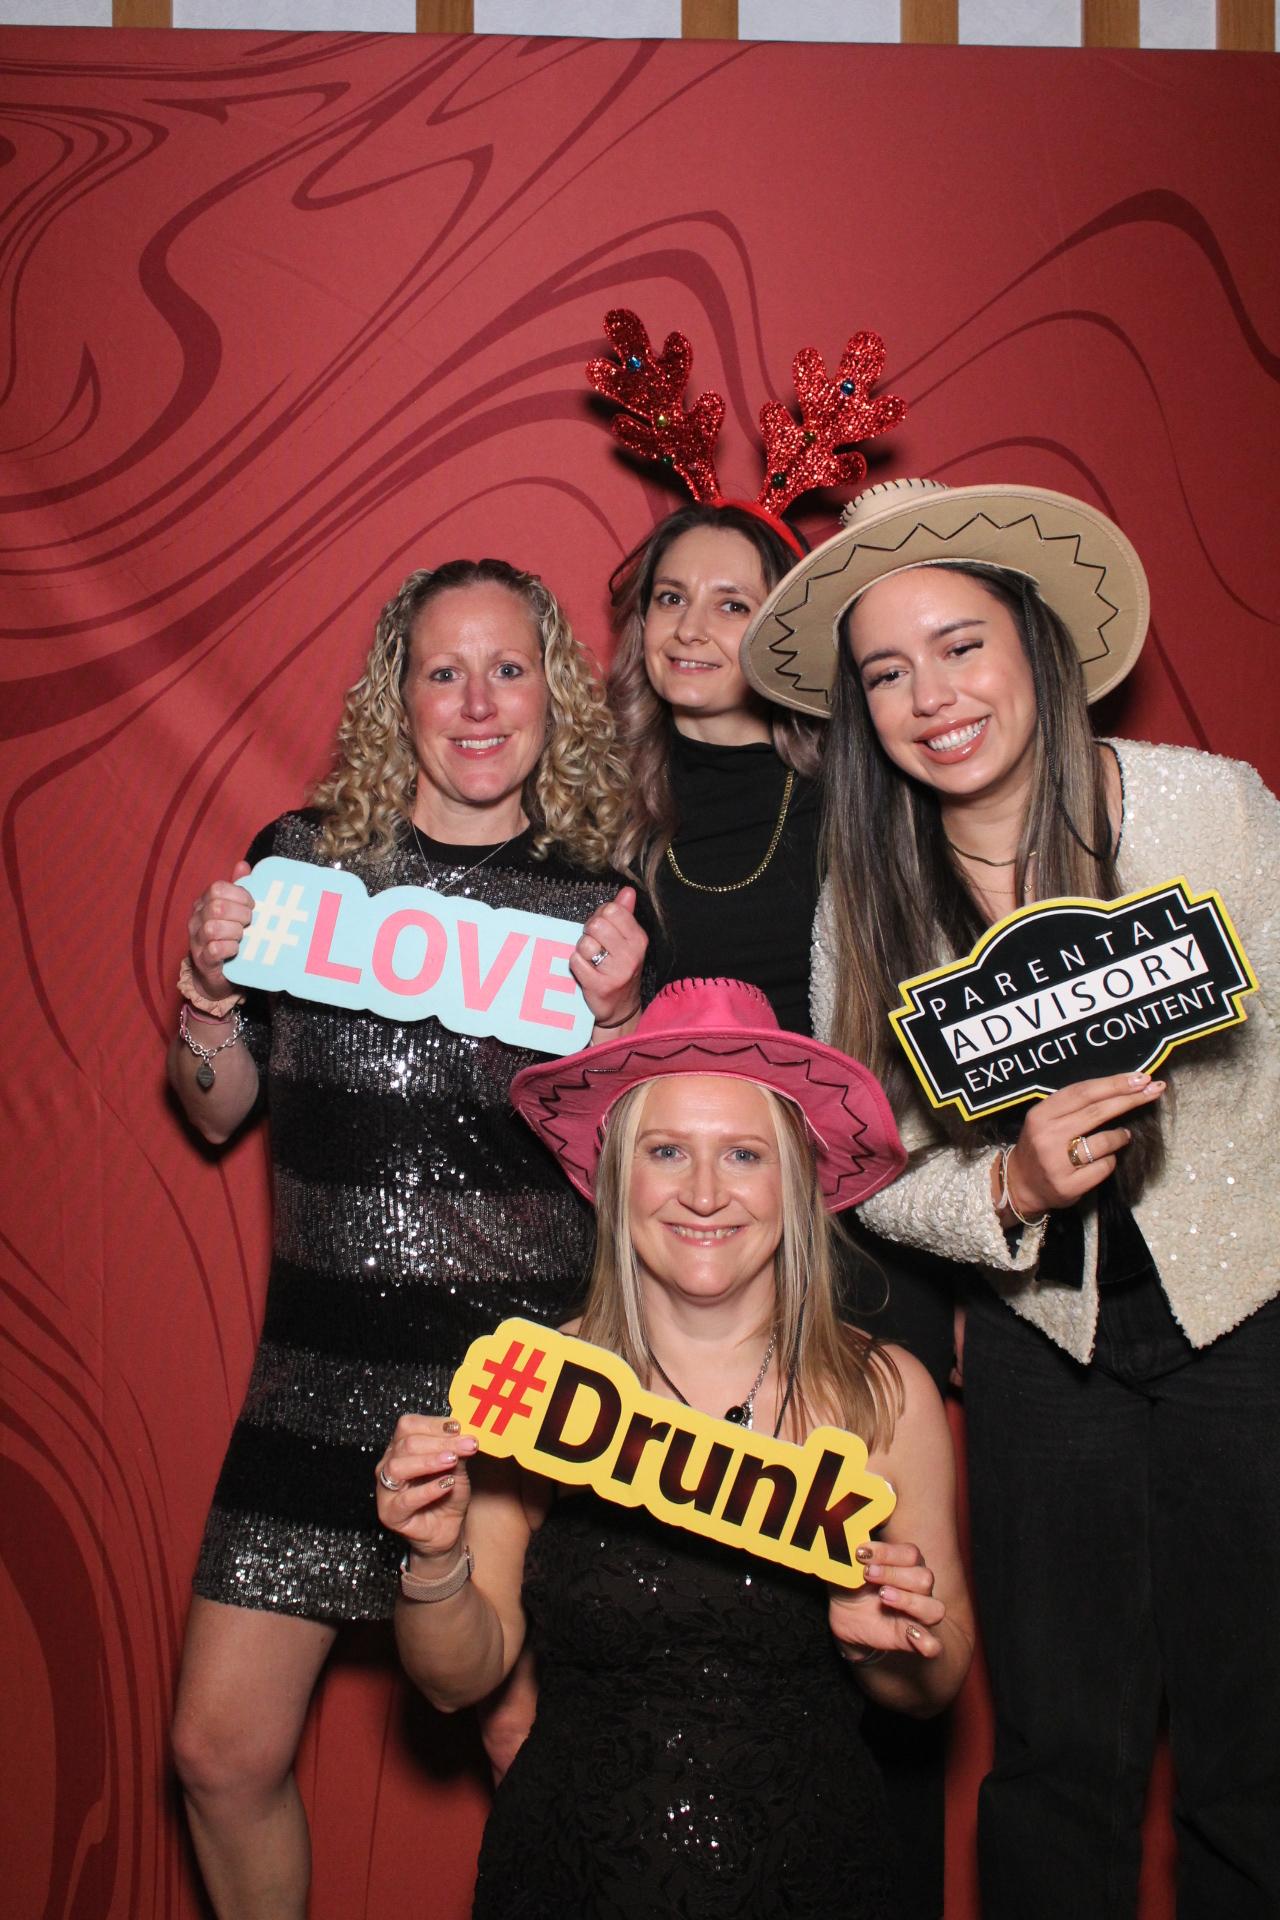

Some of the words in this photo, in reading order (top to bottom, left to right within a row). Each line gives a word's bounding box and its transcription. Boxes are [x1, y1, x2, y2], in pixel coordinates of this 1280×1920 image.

[242, 880, 579, 1031] #LOVE
[929, 909, 1187, 1020] PARENTAL
[952, 938, 1198, 1059] ADVISORY
[964, 1032, 1079, 1093] EXPLICIT
[1085, 981, 1218, 1047] CONTENT
[468, 1340, 874, 1567] #Drunk
